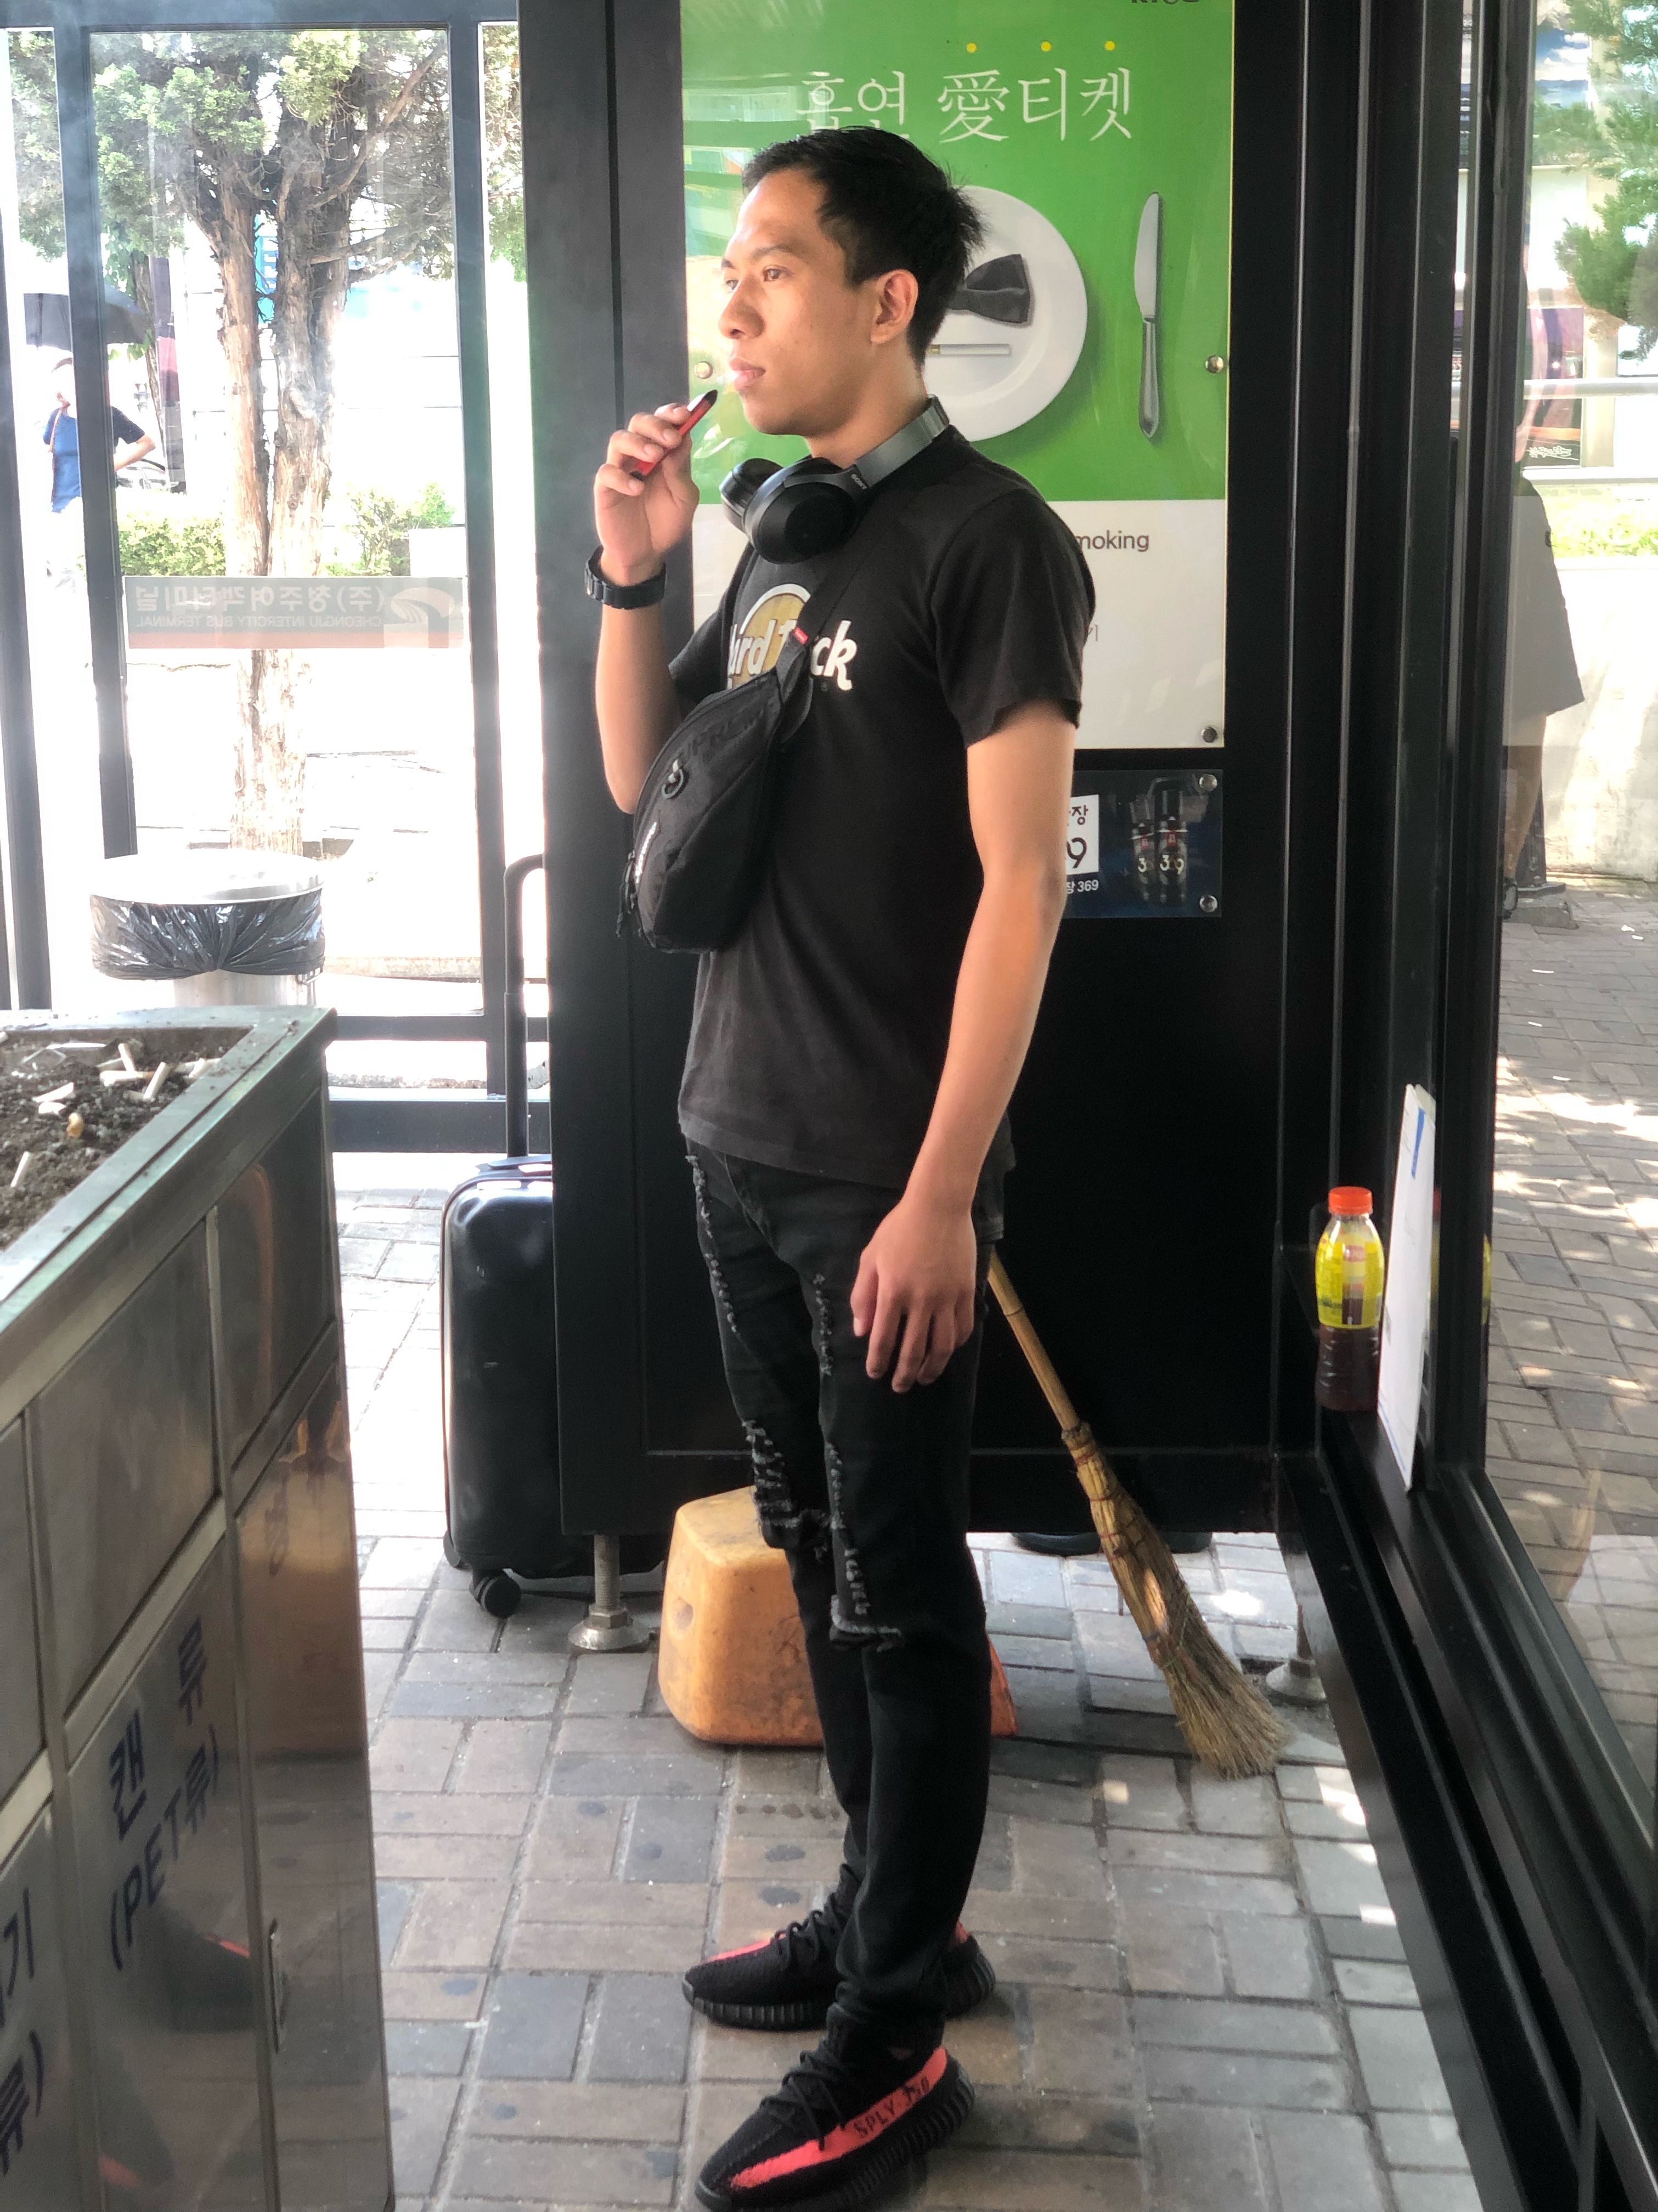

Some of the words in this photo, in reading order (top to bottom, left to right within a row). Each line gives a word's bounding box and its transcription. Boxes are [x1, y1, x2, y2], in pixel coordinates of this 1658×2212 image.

[937, 67, 1131, 142] 愛티켓
[851, 473, 867, 489] SONY
[1075, 529, 1149, 552] moking
[1069, 804, 1089, 825] 장
[1077, 879, 1099, 893] 369
[0, 1887, 35, 2028] 기
